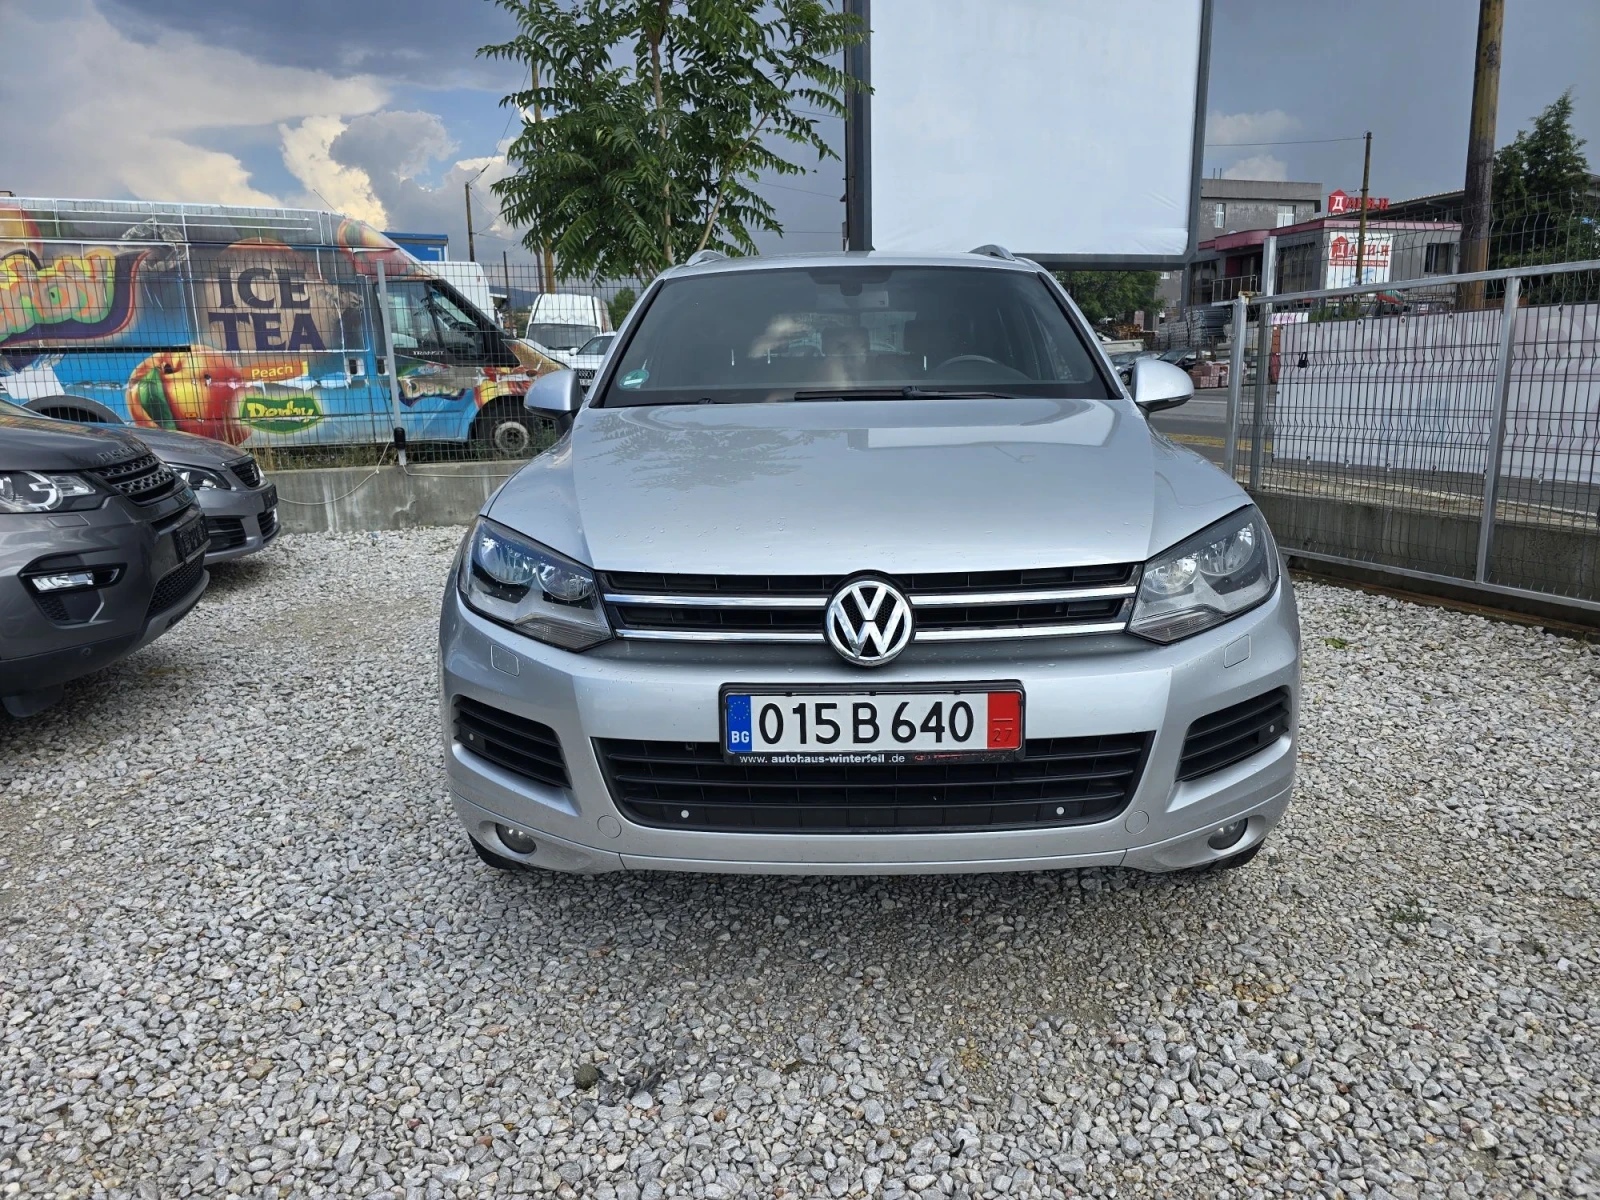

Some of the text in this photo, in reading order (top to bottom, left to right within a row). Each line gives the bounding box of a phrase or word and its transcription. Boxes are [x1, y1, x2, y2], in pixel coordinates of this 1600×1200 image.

[218, 267, 310, 309] ICE
[208, 312, 327, 351] TEA
[251, 363, 293, 379] Peach
[246, 401, 314, 423] Derby
[731, 730, 750, 744] BG
[993, 728, 1013, 742] 27
[740, 754, 768, 763] www.
